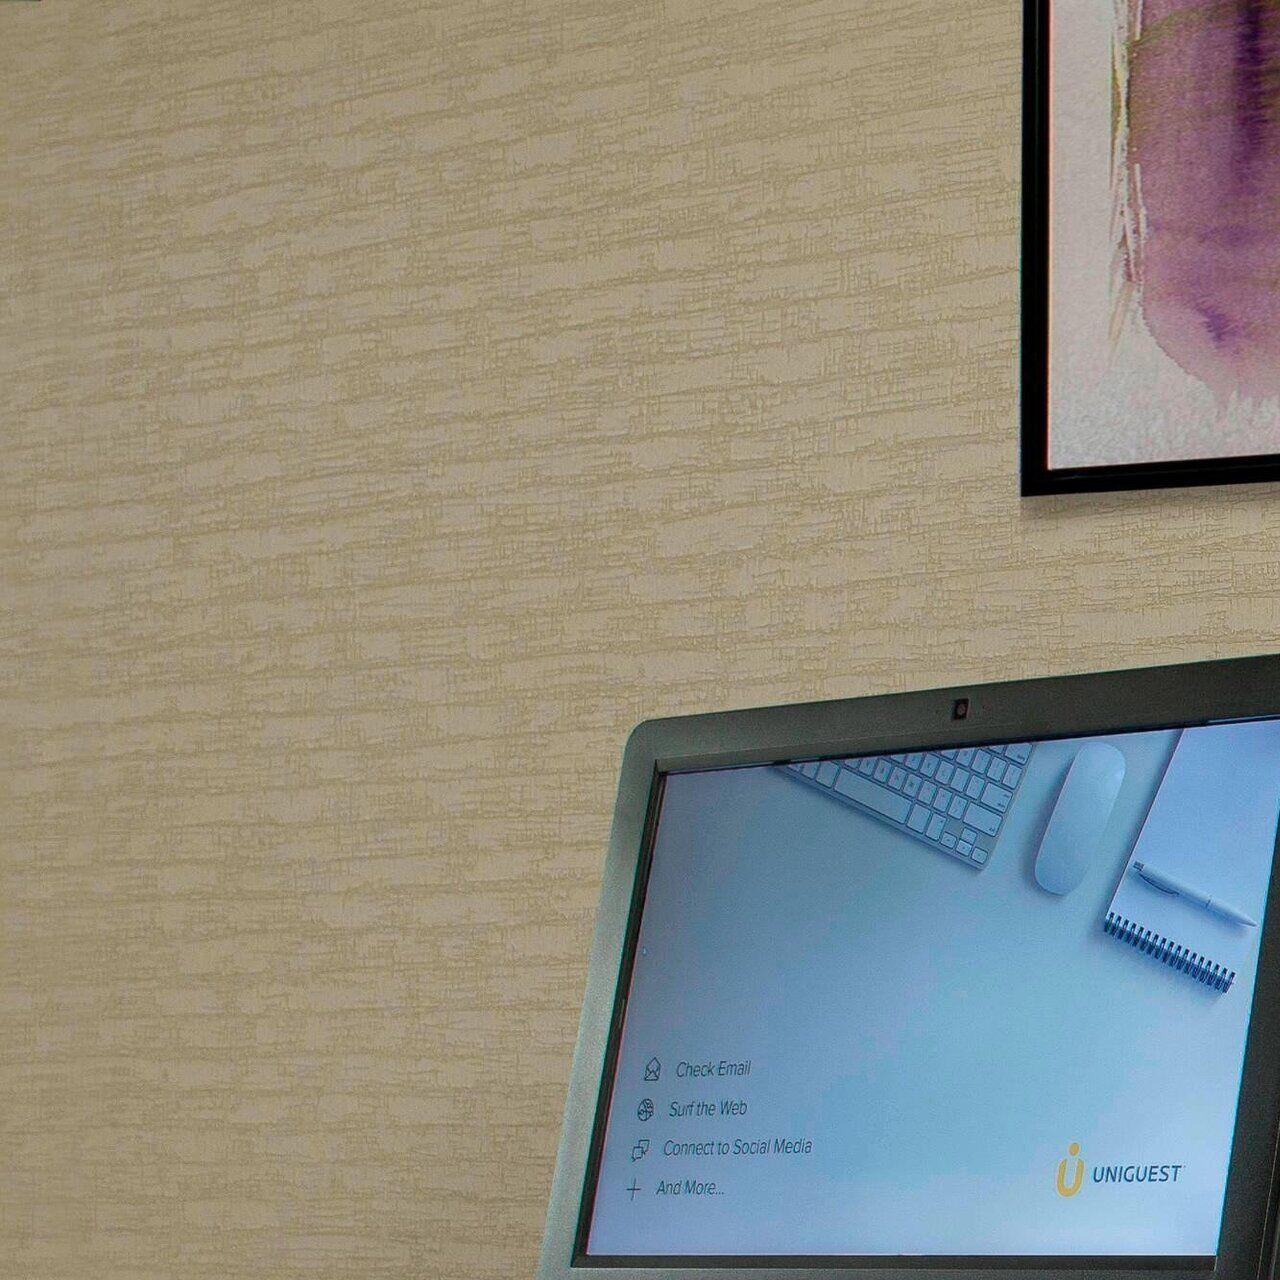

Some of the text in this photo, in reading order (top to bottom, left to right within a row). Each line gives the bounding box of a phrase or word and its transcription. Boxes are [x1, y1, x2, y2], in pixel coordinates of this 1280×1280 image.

[676, 1060, 752, 1078] Check Email
[668, 1100, 748, 1117] Surf the Web
[663, 1137, 813, 1156] Connect to Social Media
[1092, 1165, 1183, 1183] UNIGUEST
[656, 1179, 725, 1195] And More...
